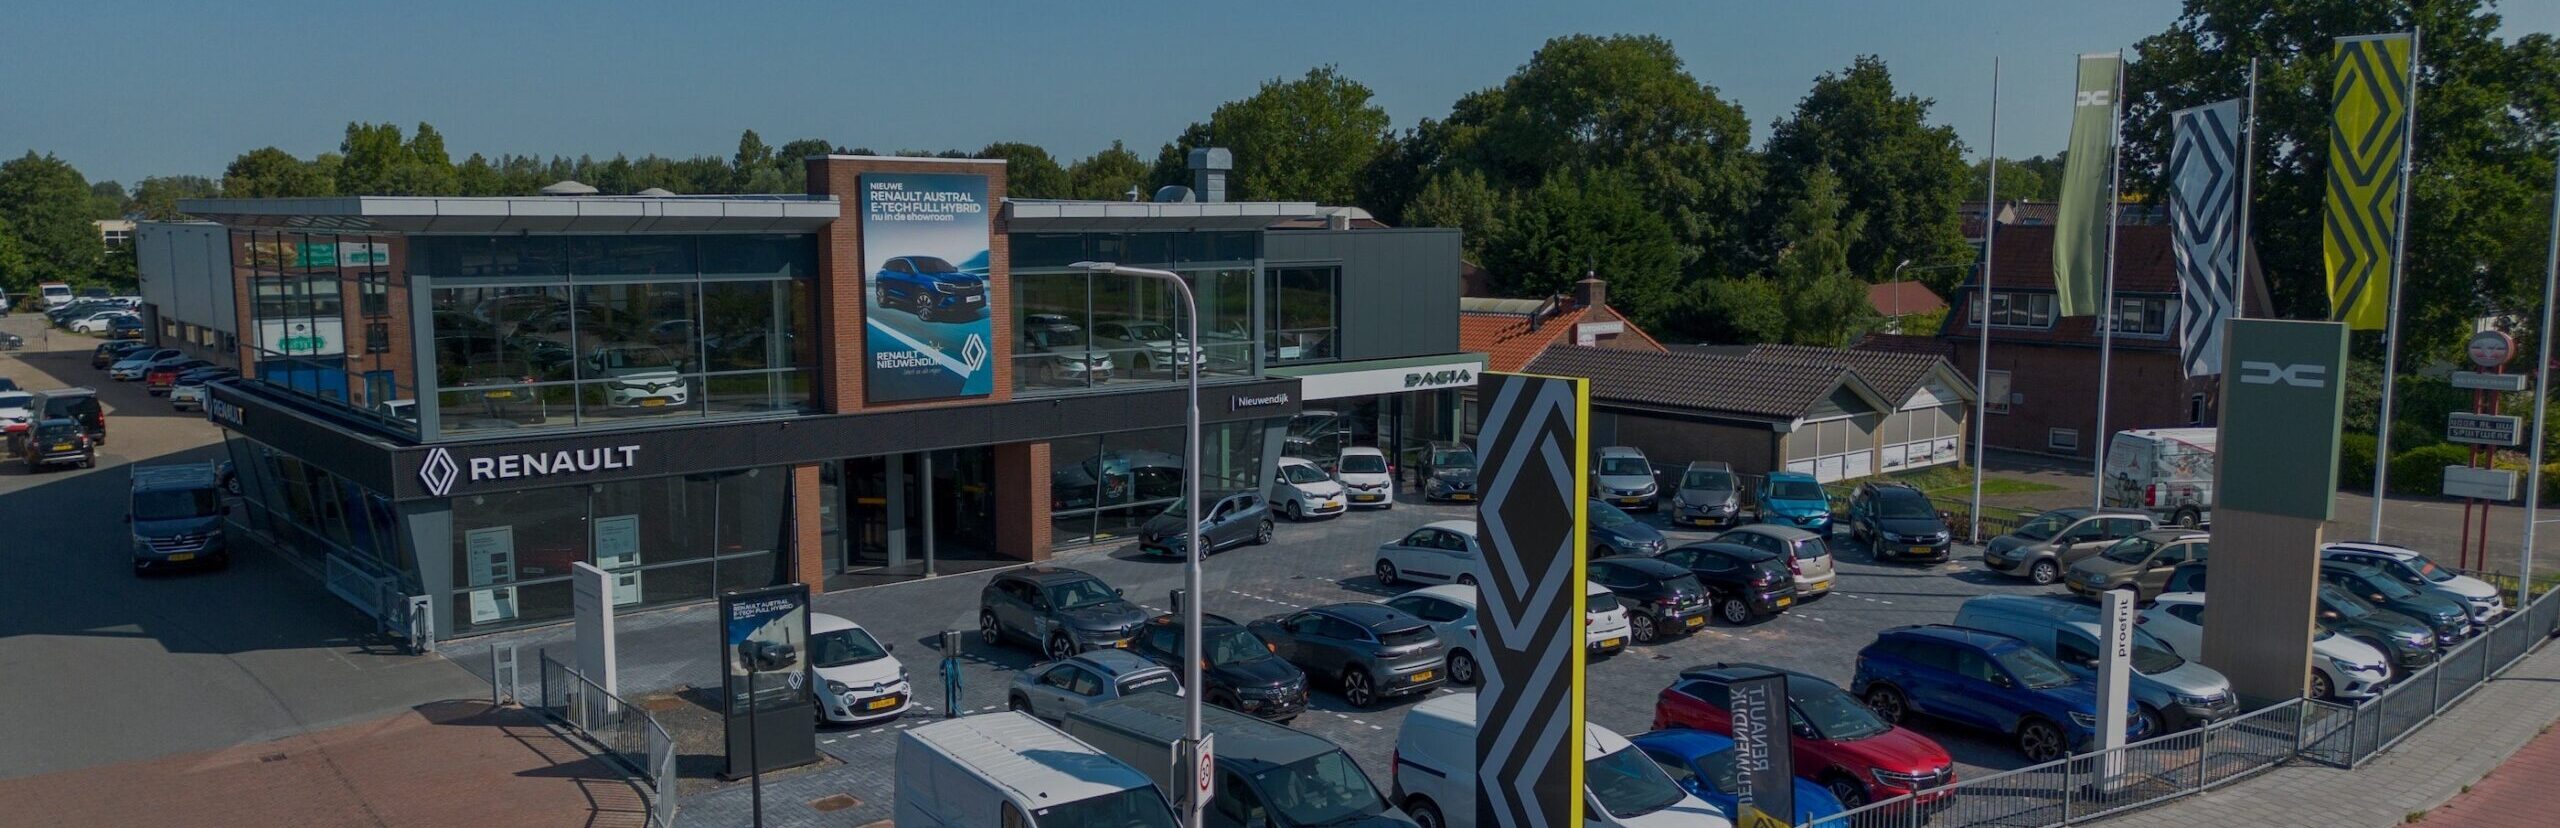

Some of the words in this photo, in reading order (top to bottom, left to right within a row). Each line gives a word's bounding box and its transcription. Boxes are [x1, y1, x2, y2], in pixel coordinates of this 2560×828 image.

[870, 191, 922, 201] RENAULT
[923, 192, 974, 202] AUSTRAL
[871, 202, 911, 213] E-TECH
[913, 203, 939, 213] FULL
[941, 203, 981, 213] HYBRID
[872, 213, 883, 221] nu
[884, 212, 893, 221] in
[894, 212, 906, 221] de
[906, 212, 954, 221] showroom
[876, 350, 918, 361] RENAULT
[877, 358, 941, 369] NIEUWENDIJK
[1404, 369, 1472, 388] DACIA
[1238, 393, 1289, 407] Nieuwendijk
[470, 445, 640, 480] RENAULT
[2119, 599, 2128, 657] proefrit
[1202, 763, 1209, 781] 30
